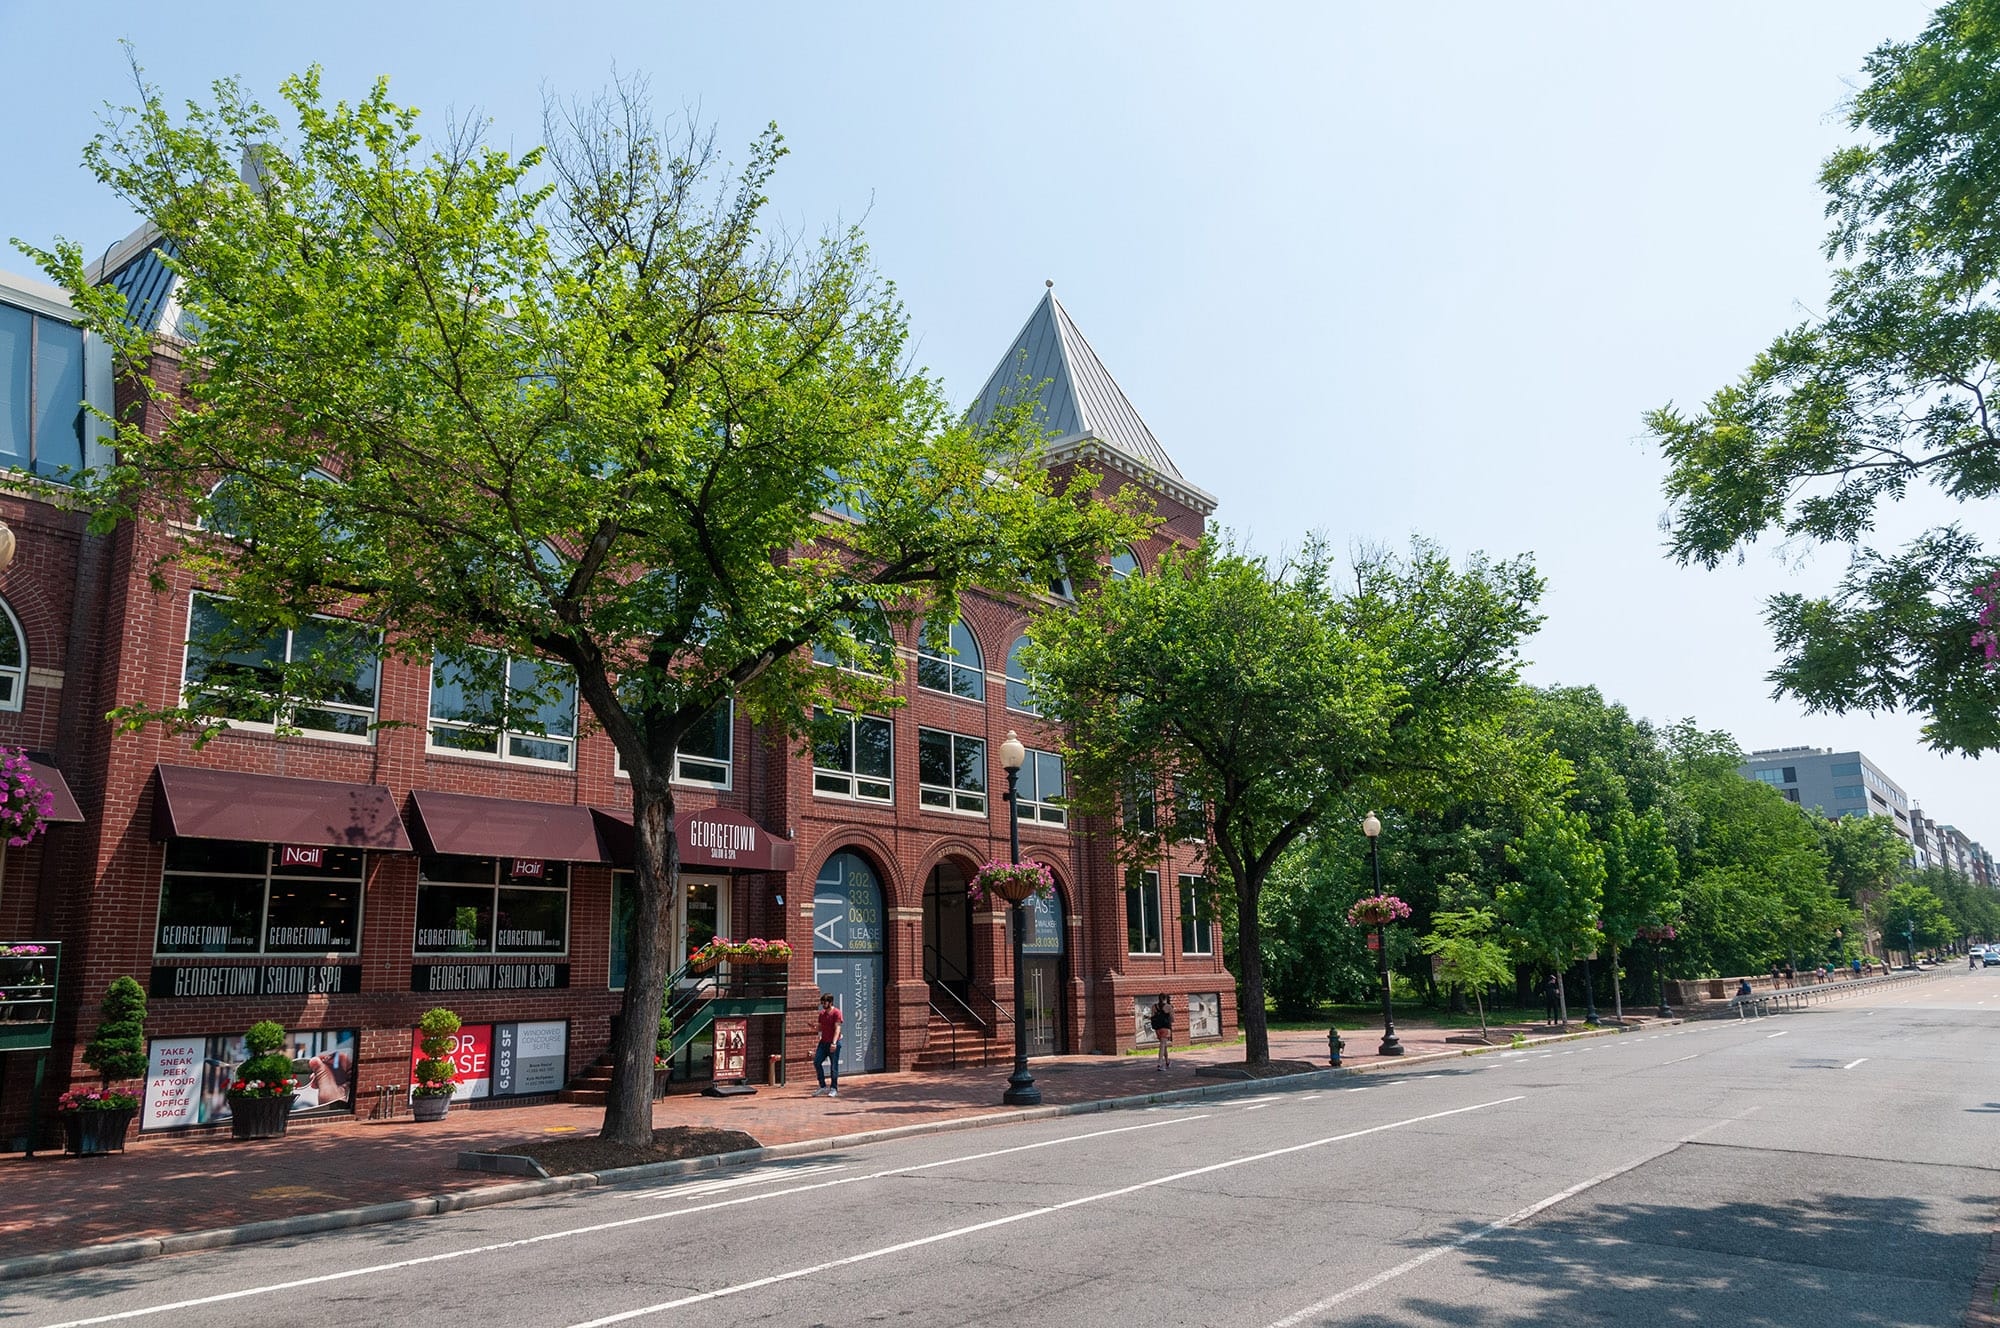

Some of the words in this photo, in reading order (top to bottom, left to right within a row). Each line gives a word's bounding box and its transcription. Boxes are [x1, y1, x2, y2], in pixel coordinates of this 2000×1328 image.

[691, 820, 755, 851] GEORGETOWN
[286, 847, 319, 863] Nail
[516, 860, 542, 874] Hair
[848, 907, 876, 923] 0303
[162, 925, 227, 945] GEORGETOWN
[269, 926, 328, 945] GEORGETOWN
[418, 928, 467, 946] GEORGETOWN
[498, 929, 542, 946] GEORGETOWN
[175, 967, 256, 996] GEORGETOWN
[267, 966, 305, 994] SALON
[307, 966, 316, 993] &
[319, 966, 341, 993] SPA
[429, 965, 490, 991] GEORGETOWN
[498, 964, 527, 989] SALON
[529, 964, 536, 988] &
[538, 964, 556, 988] SPA
[854, 963, 862, 1009] WALKER
[502, 1029, 511, 1047] SF
[855, 1022, 863, 1062] MILLER
[160, 1047, 185, 1056] TAKE
[160, 1058, 192, 1066] SNEAK
[500, 1050, 511, 1089] 6,563
[163, 1068, 187, 1076] PEEK
[153, 1079, 166, 1087] AT
[168, 1077, 195, 1086] YOUR
[161, 1088, 185, 1097] NEW
[154, 1098, 190, 1108] OFFICE
[156, 1108, 187, 1118] SPACE
